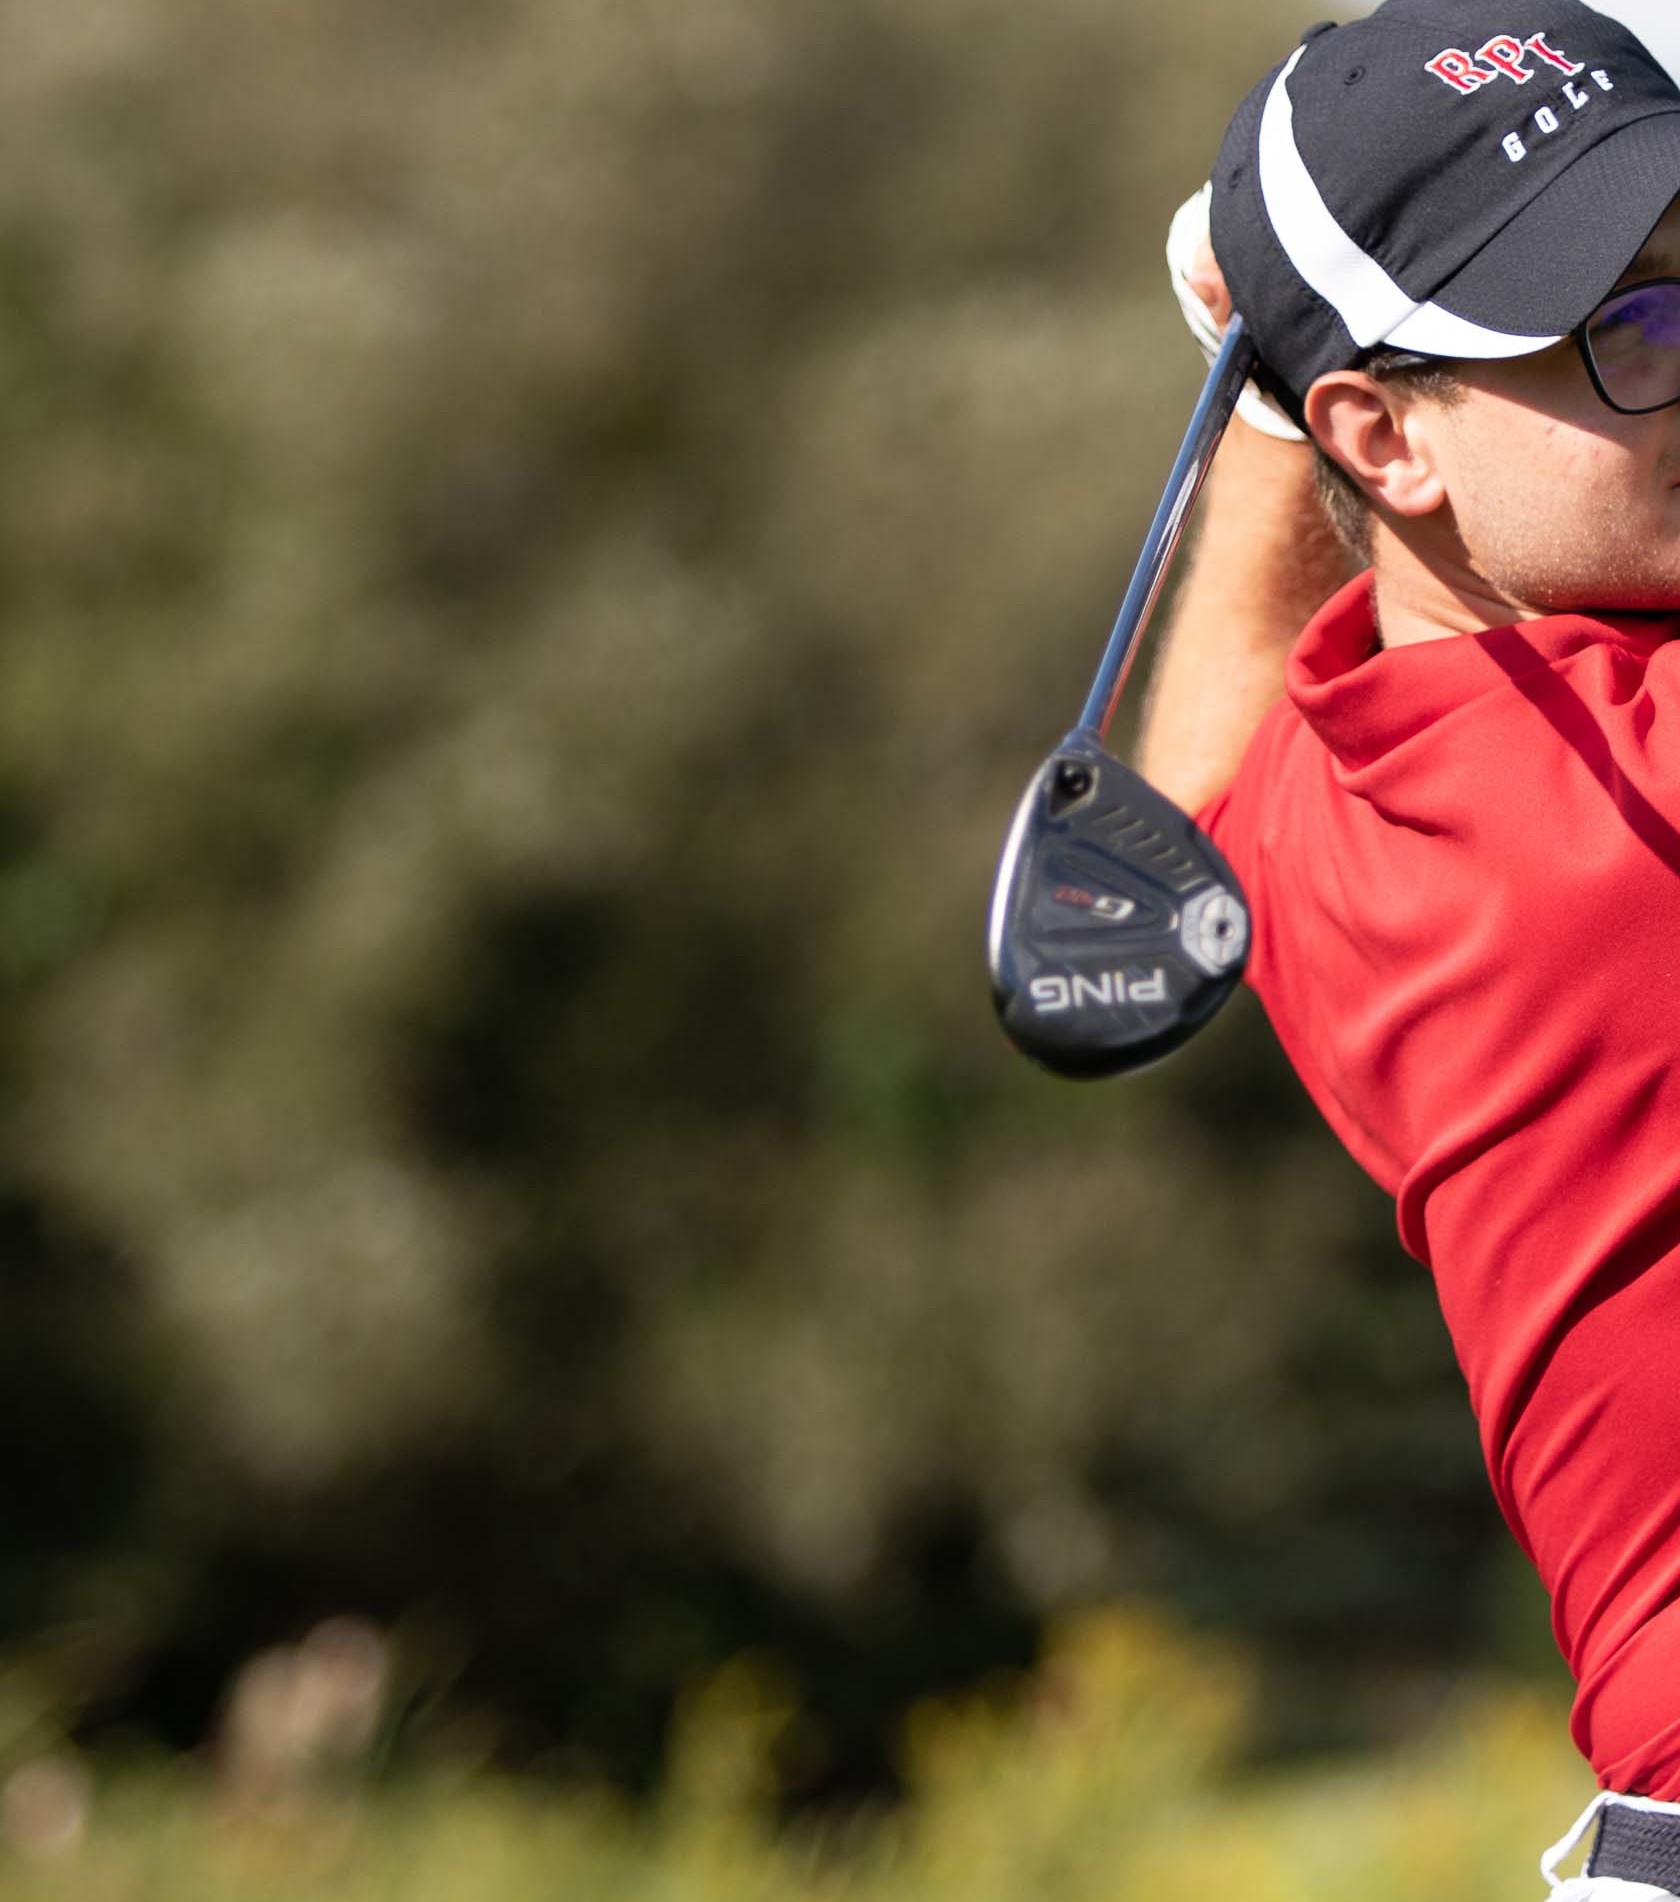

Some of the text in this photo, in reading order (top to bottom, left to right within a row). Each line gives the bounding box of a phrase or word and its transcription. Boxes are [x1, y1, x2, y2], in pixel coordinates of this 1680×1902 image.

[1424, 32, 1585, 95] RPI
[1502, 69, 1614, 162] GOLF
[1030, 967, 1166, 1012] PING
